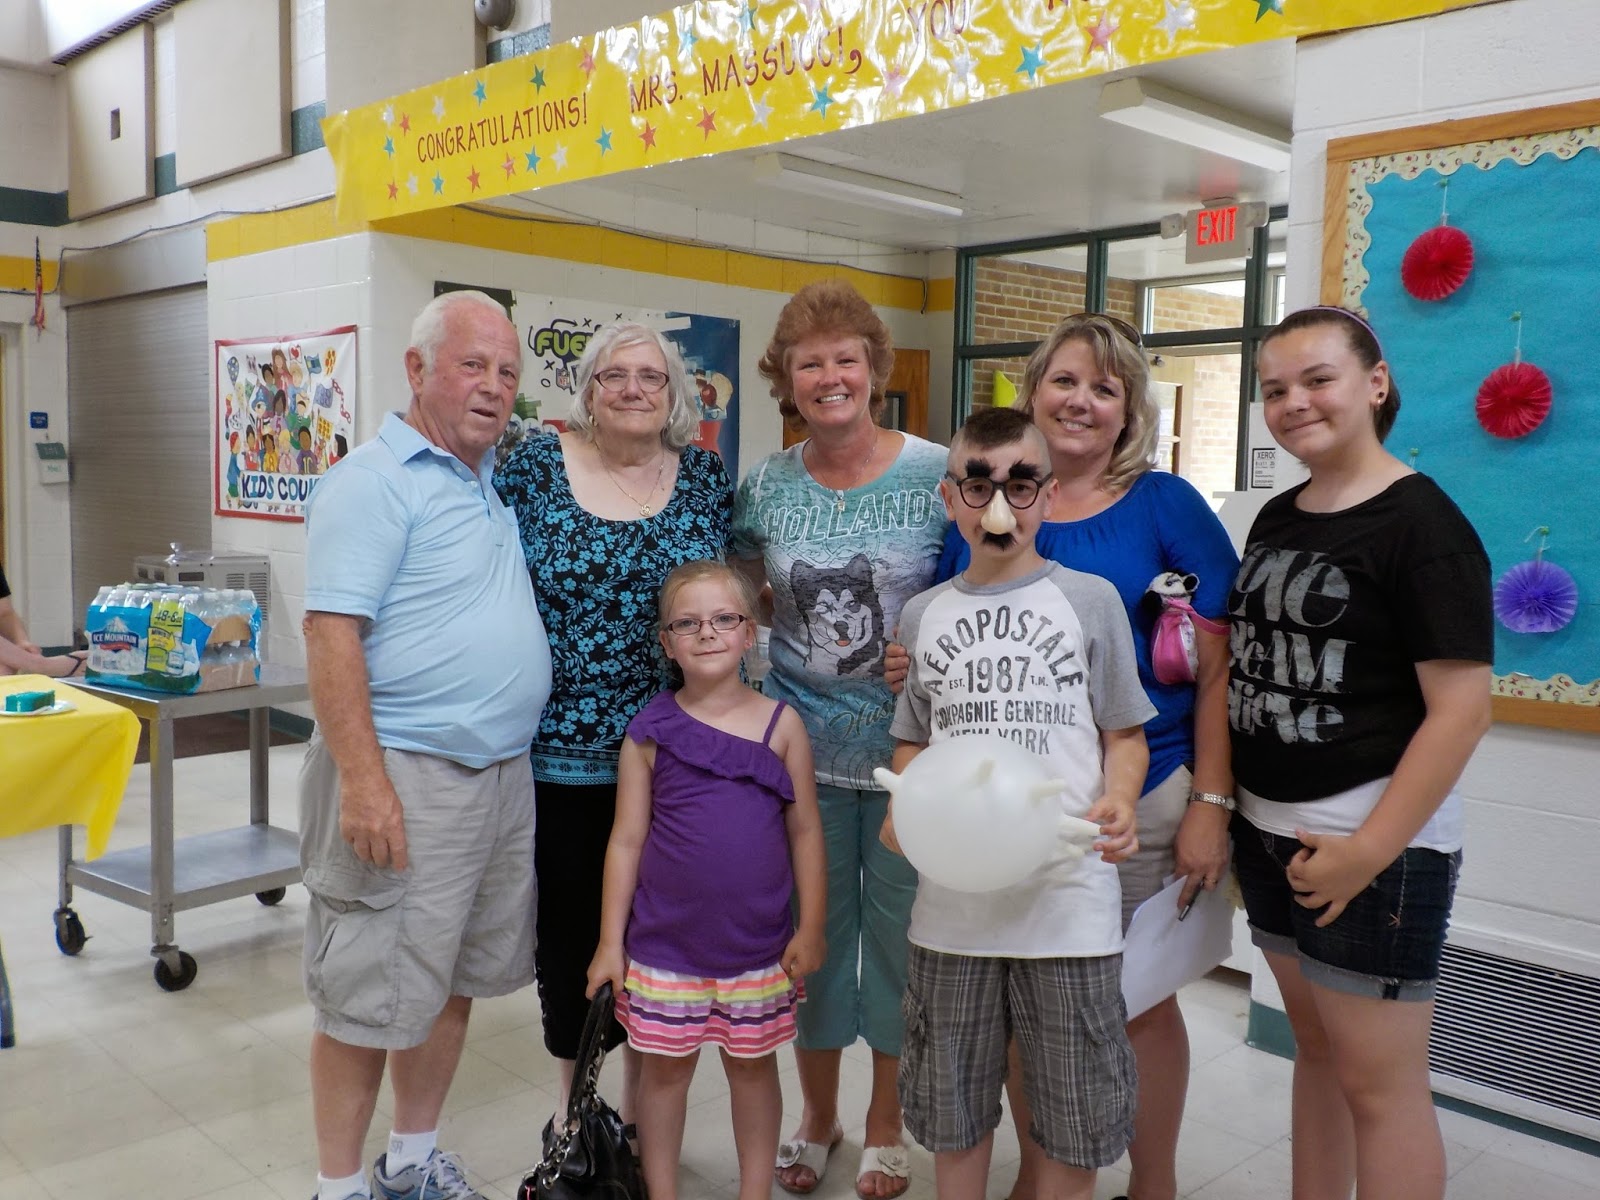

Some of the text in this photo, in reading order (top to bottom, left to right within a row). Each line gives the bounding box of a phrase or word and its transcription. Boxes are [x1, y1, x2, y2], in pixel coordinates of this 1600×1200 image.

[417, 93, 588, 163] CONGRATULATIONS!
[629, 70, 684, 114] MRS.
[702, 26, 862, 96] MASSUCCI,
[1197, 206, 1239, 246] EXIT
[241, 475, 275, 500] KIDS
[758, 488, 933, 548] HOLLAND
[93, 632, 138, 644] ICE MOUNTAIN
[949, 677, 966, 690] EST.
[964, 656, 1032, 694] 1987
[1004, 699, 1076, 727] GENERALE
